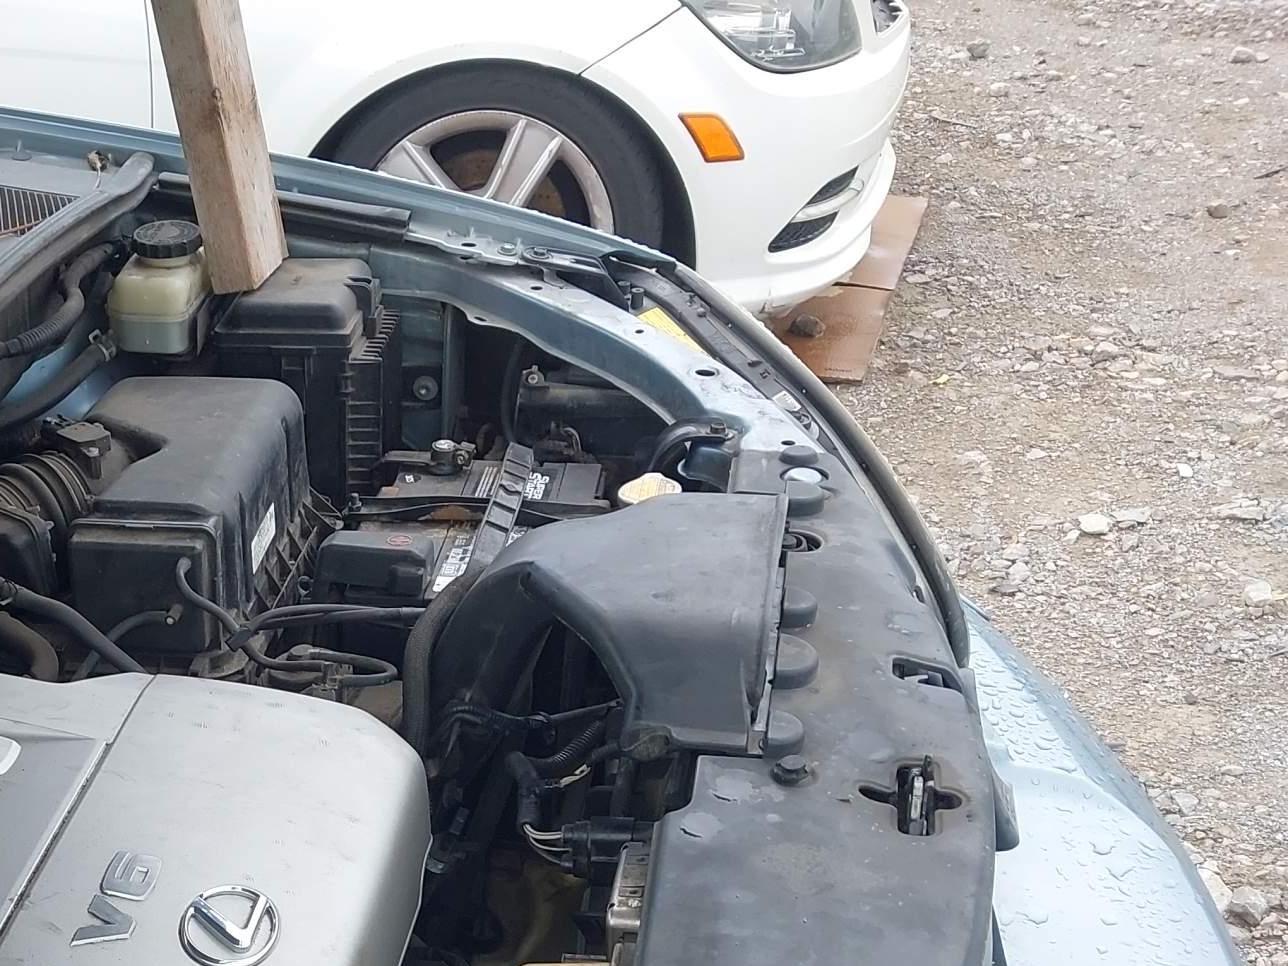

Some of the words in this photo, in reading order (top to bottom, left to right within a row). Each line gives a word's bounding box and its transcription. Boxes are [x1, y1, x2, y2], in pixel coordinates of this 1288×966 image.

[523, 472, 542, 499] START
[533, 475, 550, 500] SUPER
[70, 848, 163, 947] V6
